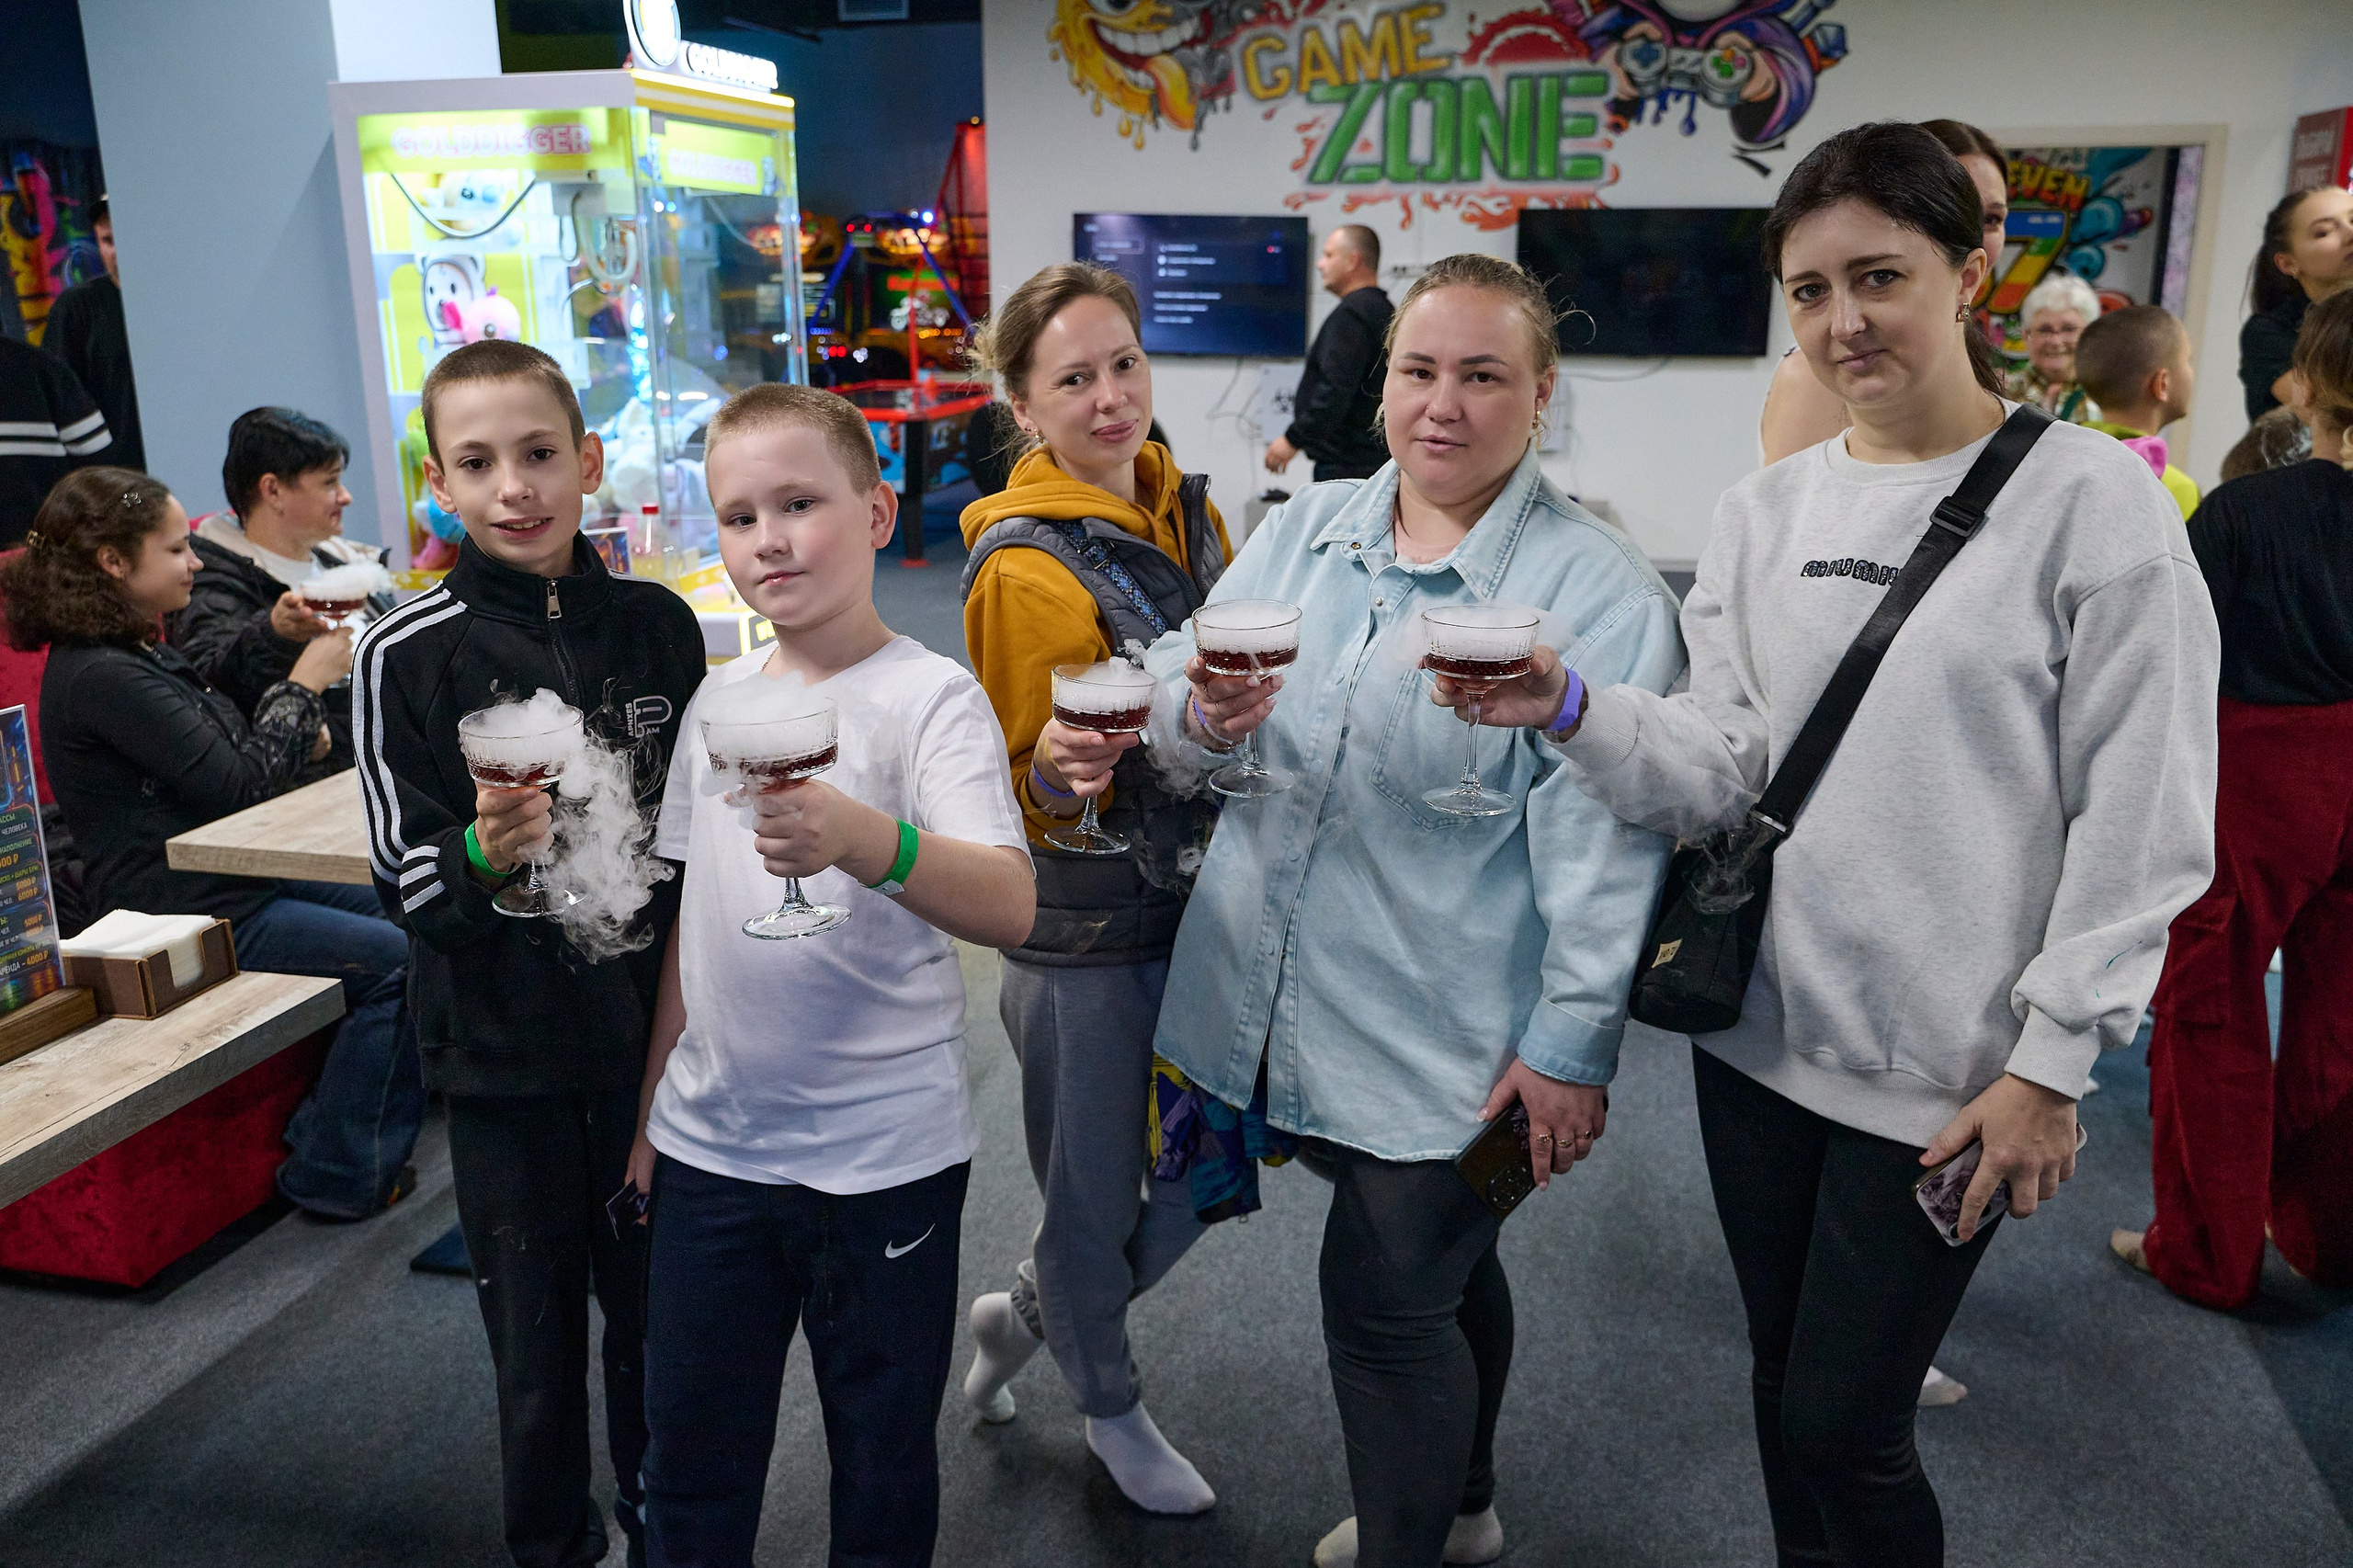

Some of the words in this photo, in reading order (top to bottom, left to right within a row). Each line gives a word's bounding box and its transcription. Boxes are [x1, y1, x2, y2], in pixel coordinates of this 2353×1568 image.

[1241, 3, 1452, 101] GAME
[392, 123, 592, 159] GOLDDIGGER
[1305, 71, 1609, 184] ZONE
[2007, 160, 2091, 211] EVEN
